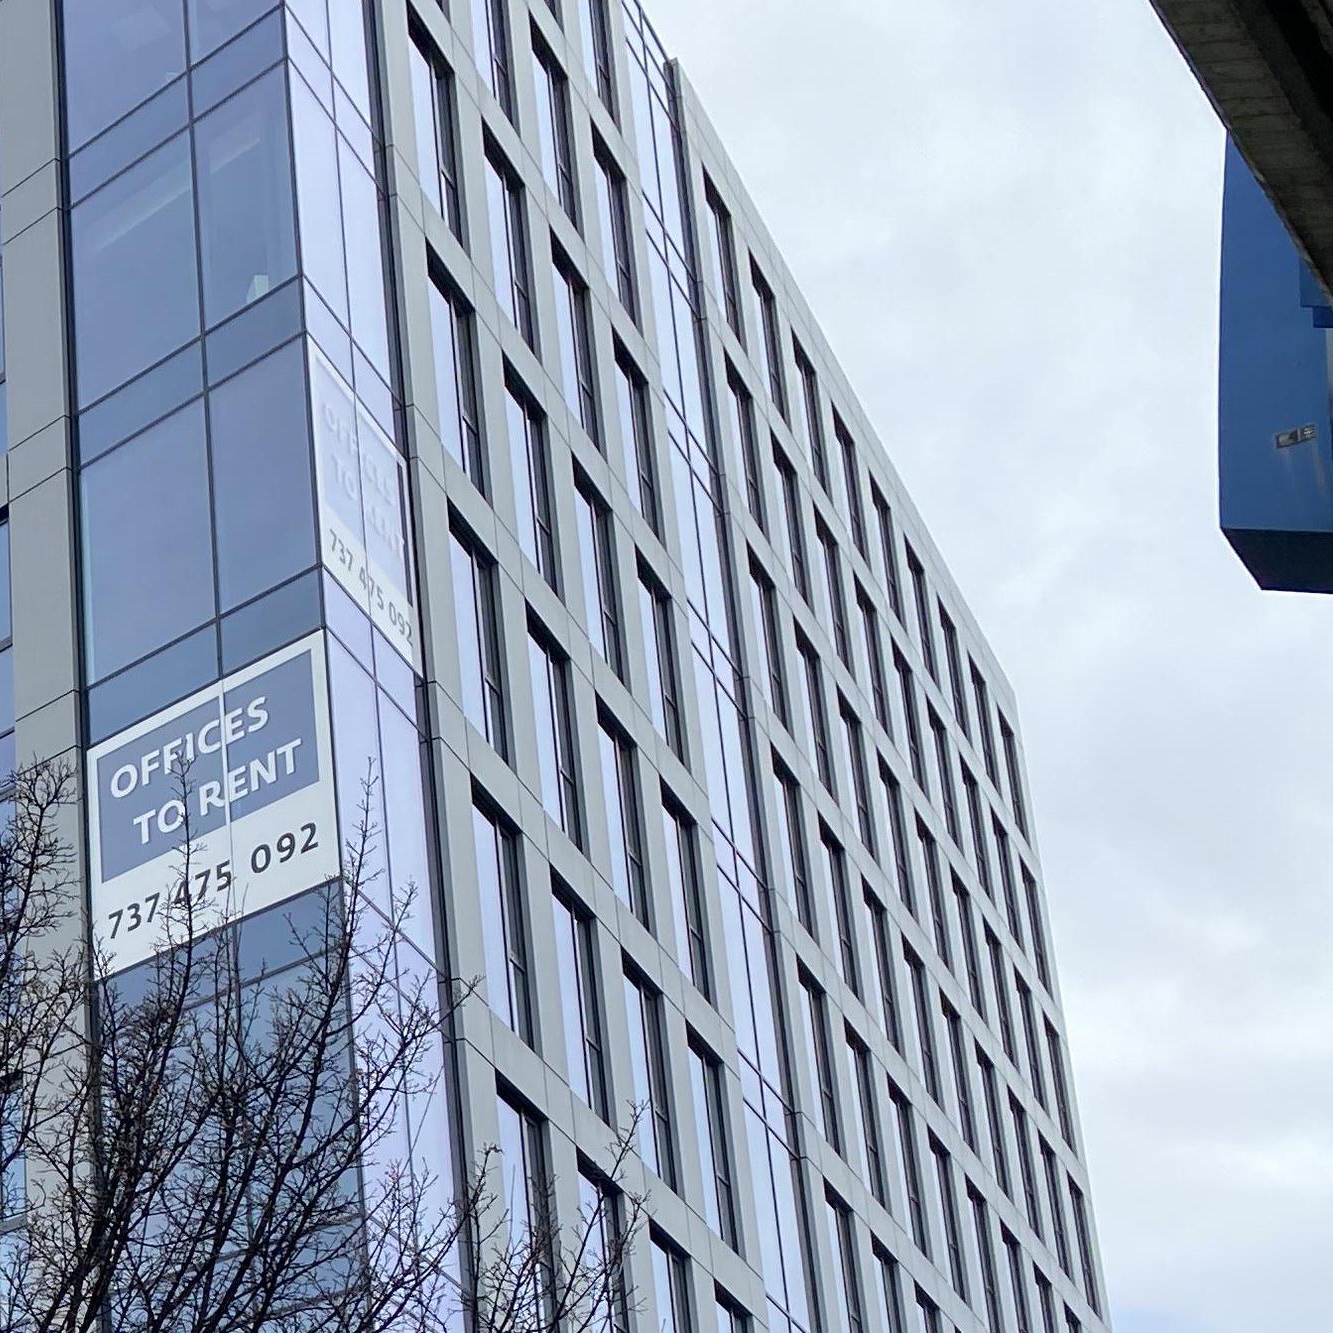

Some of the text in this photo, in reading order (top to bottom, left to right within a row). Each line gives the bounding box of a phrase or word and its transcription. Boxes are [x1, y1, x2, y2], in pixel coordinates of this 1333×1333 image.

[329, 528, 413, 648] 737 475 092
[110, 696, 269, 799] OFFICES
[133, 738, 302, 845] TO RENT
[108, 822, 319, 940] 737 475 092
